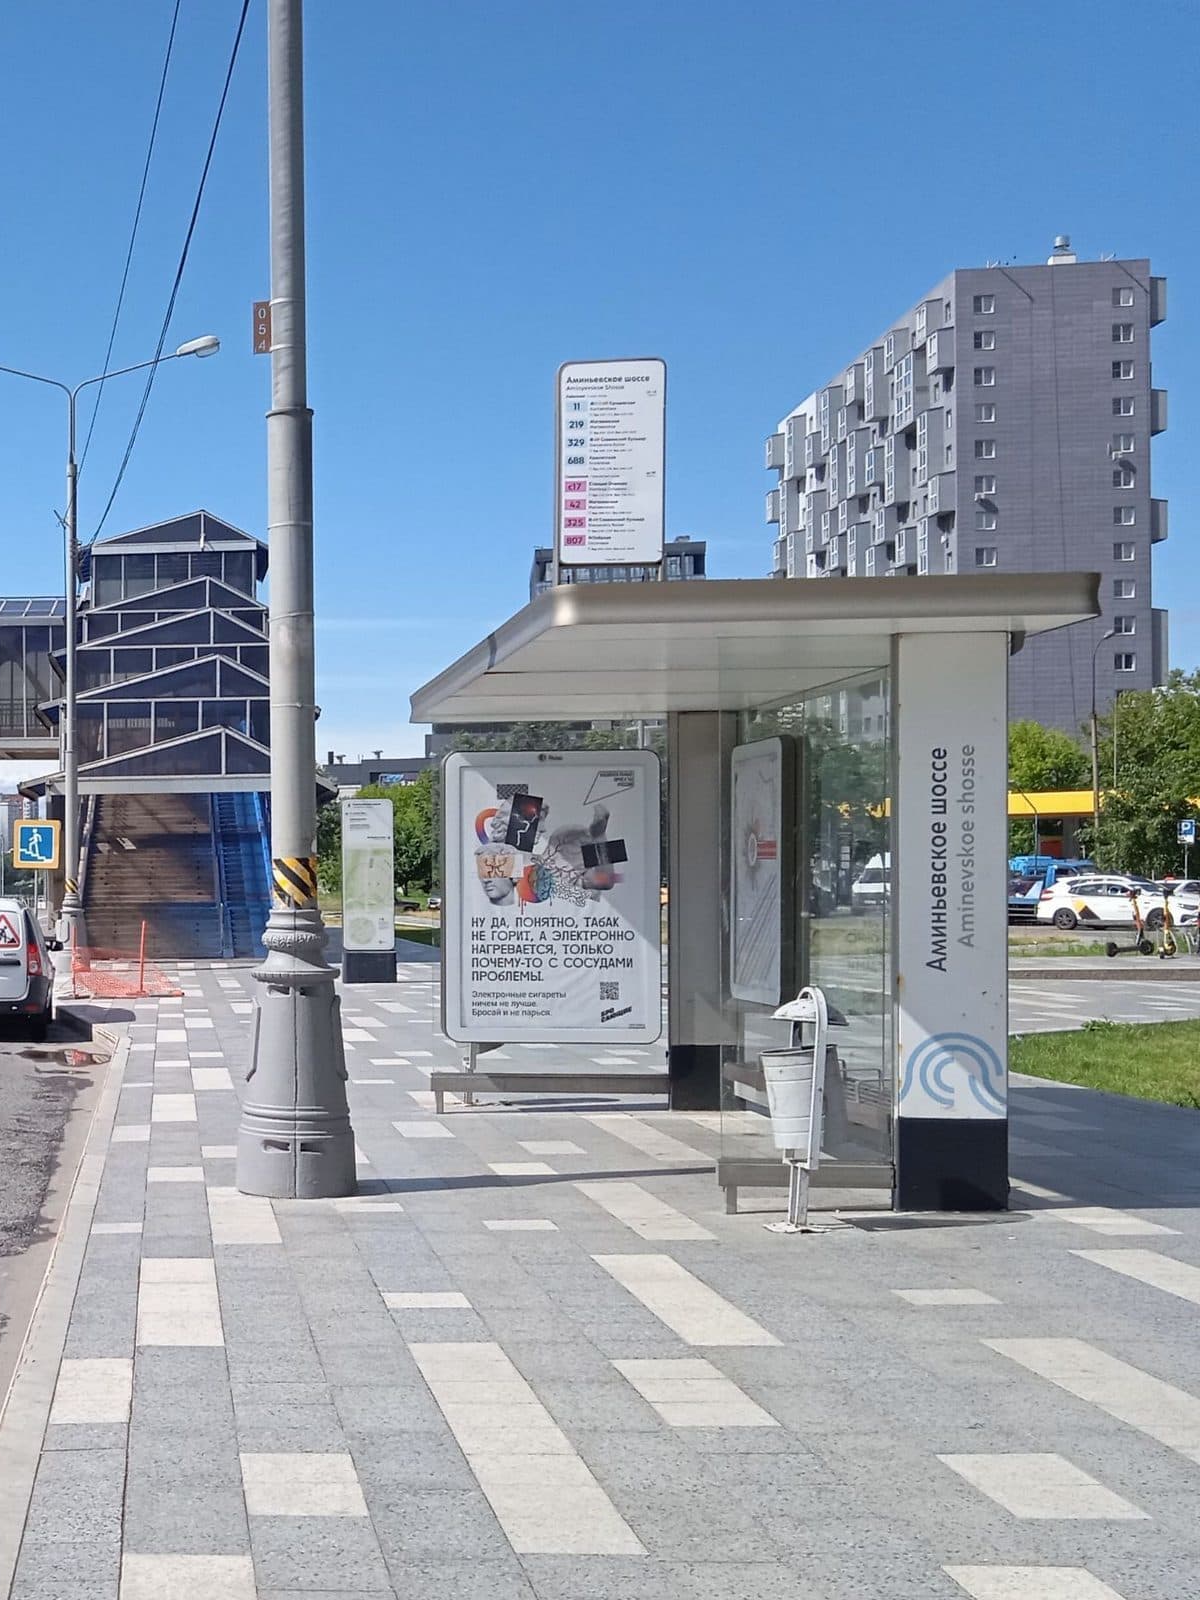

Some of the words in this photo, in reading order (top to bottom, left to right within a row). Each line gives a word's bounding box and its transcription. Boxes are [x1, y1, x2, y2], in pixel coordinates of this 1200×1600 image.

[257, 307, 267, 352] 054
[566, 376, 622, 384] Аминьевское
[624, 375, 650, 383] шоссе
[573, 402, 580, 411] 11
[569, 420, 584, 429] 219
[567, 438, 585, 447] 329
[567, 456, 585, 465] 688
[569, 500, 581, 509] 42
[567, 519, 584, 527] 325
[566, 536, 583, 545] 807
[931, 747, 947, 815] шоссе
[956, 744, 975, 814] shosse
[956, 820, 975, 948] Aminevskoe
[926, 822, 947, 973] Аминьевское
[471, 916, 486, 928] НУ
[490, 916, 510, 929] ДА,
[515, 916, 579, 929] ПОНЯТНО,
[471, 930, 486, 941] НЕ
[491, 930, 534, 942] ГОРИТ,
[539, 930, 547, 941] А
[552, 930, 635, 941] ЭЛЕКТРОННО
[471, 944, 557, 956] НАГРЕВАЕТСЯ,
[562, 944, 614, 955] ТОЛЬКО
[471, 957, 543, 968] ПОЧЕМУ-ТО
[548, 957, 558, 968] С
[563, 957, 634, 970] СОСУДАМИ
[471, 990, 527, 1000] Электронные
[528, 991, 567, 1001] сигареты
[471, 1008, 502, 1017] Бросай
